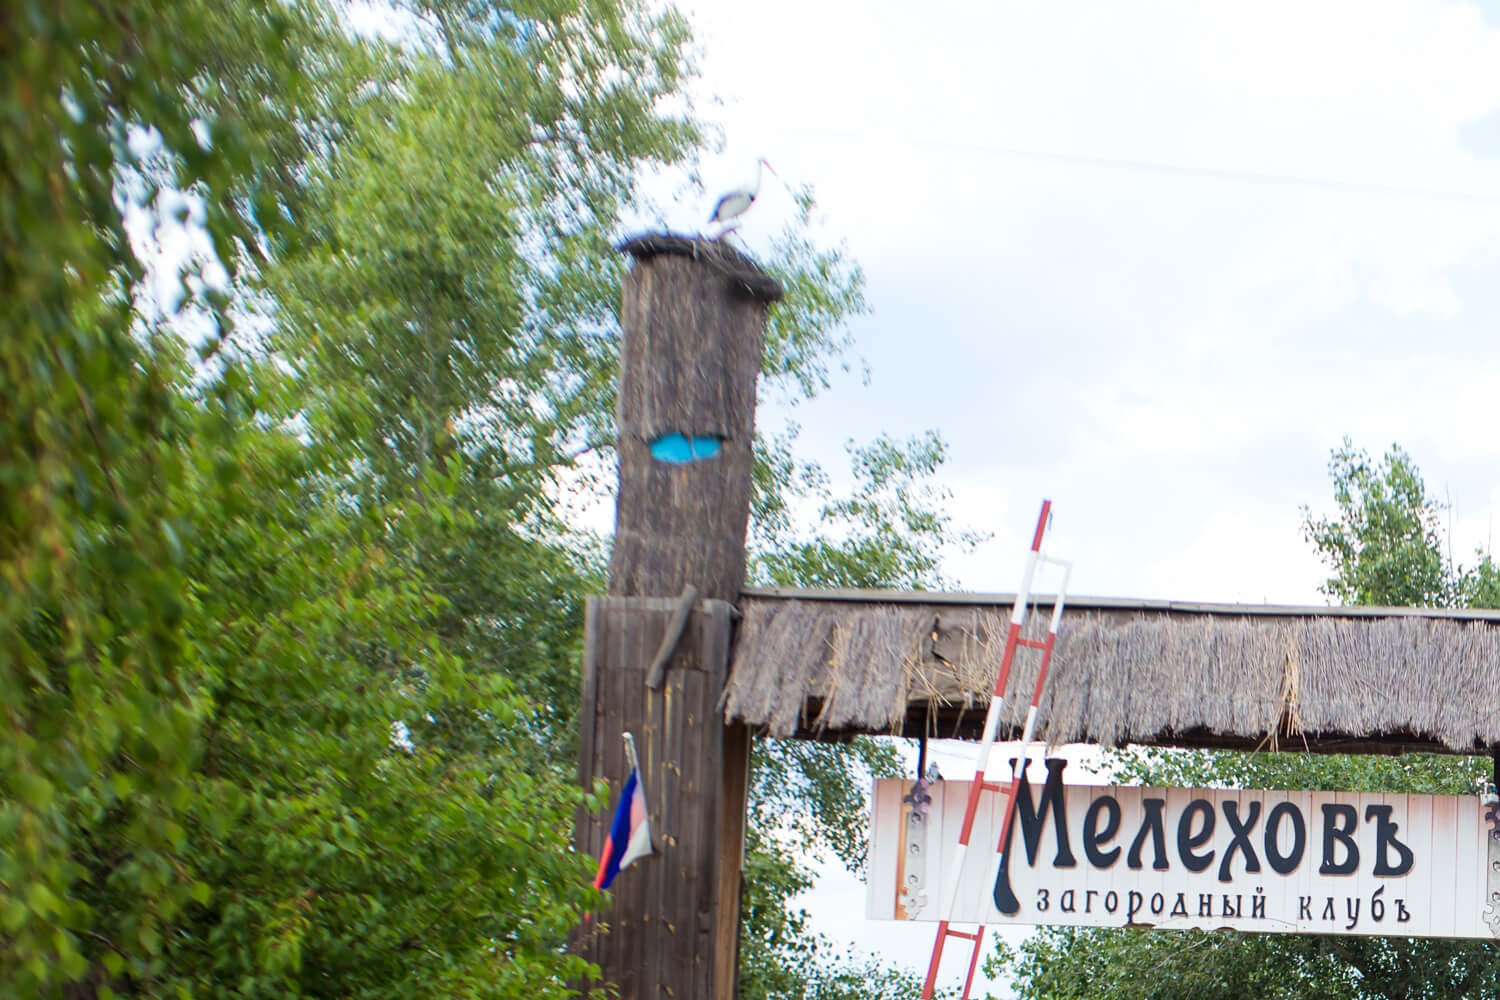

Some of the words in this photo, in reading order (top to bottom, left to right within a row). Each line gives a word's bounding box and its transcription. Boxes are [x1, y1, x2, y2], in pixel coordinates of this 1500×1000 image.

[993, 758, 1414, 914] Мелеховъ
[1036, 886, 1267, 925] загородный
[1299, 884, 1411, 930] клубъ
